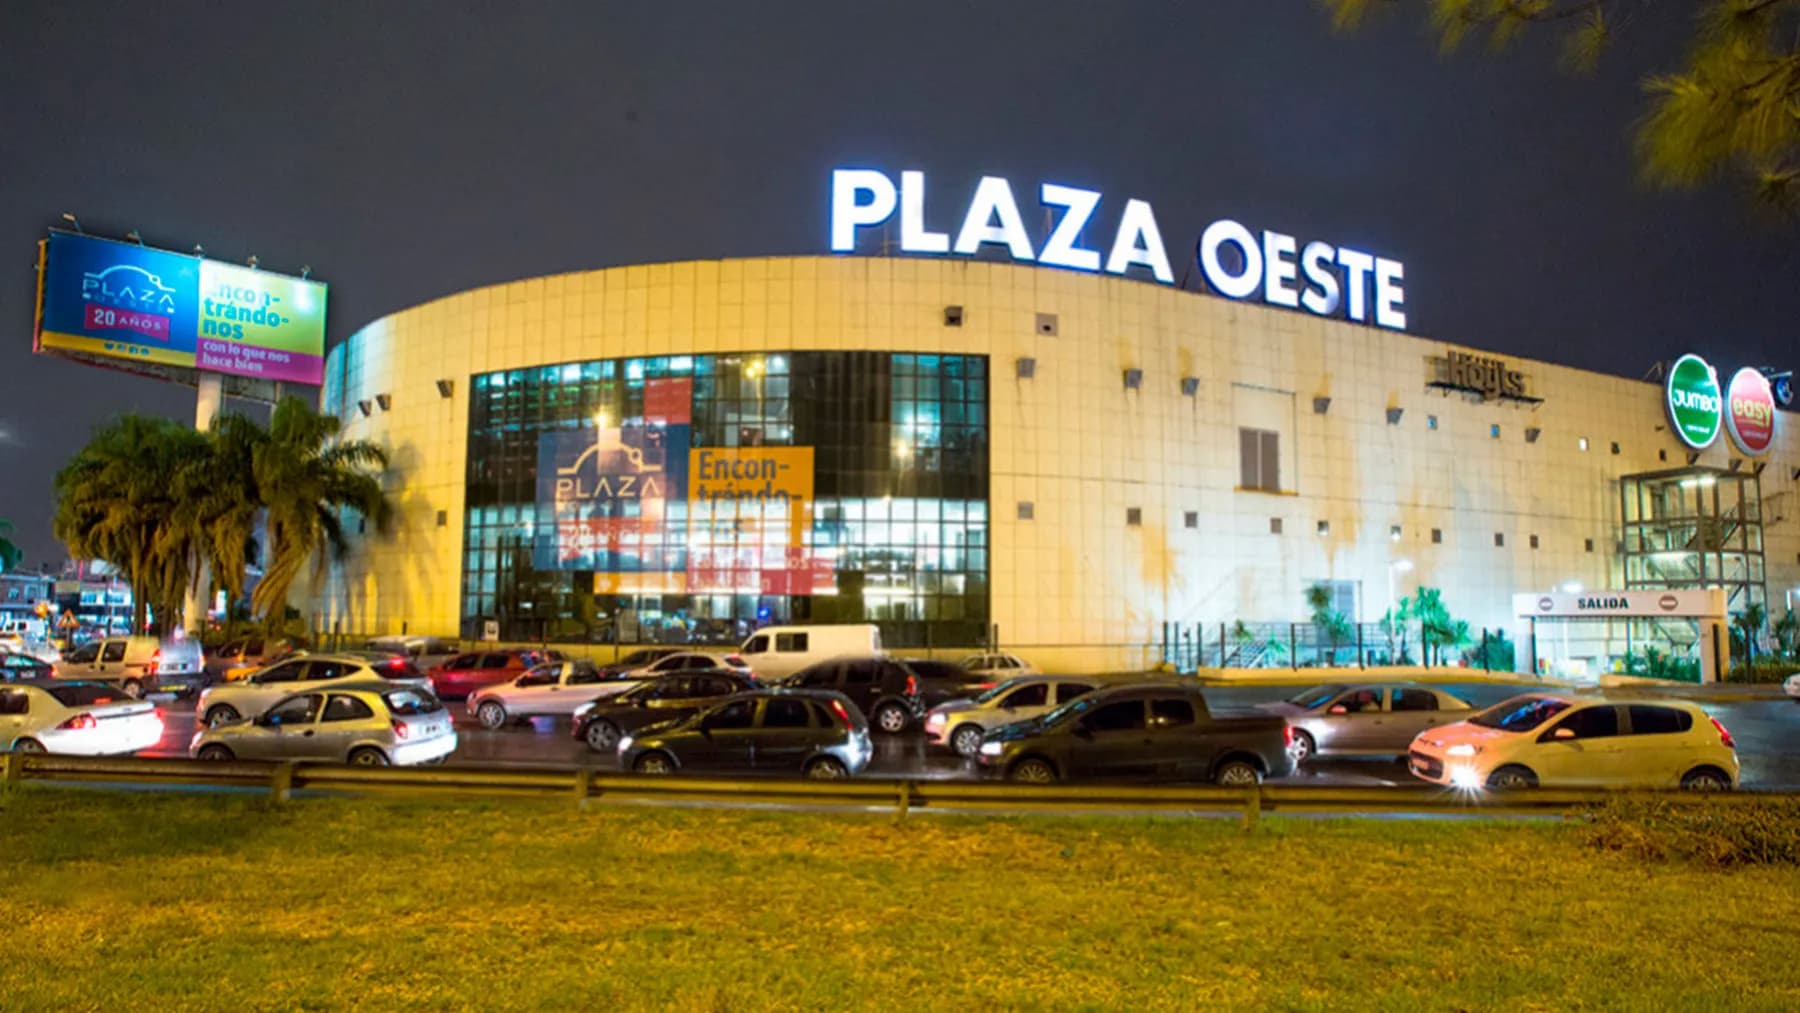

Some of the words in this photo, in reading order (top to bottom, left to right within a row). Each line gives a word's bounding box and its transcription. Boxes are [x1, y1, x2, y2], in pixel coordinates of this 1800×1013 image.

[831, 169, 1175, 284] PLAZA
[1198, 219, 1407, 330] OESTE
[82, 279, 175, 306] PLAZA
[94, 308, 116, 326] 20
[204, 297, 289, 328] trándo-
[203, 318, 244, 340] nos
[203, 341, 226, 353] con
[229, 343, 240, 355] lo
[243, 347, 266, 361] que
[268, 351, 291, 363] nos
[203, 353, 232, 369] hace
[235, 357, 263, 373] bien
[1732, 397, 1773, 428] easy
[699, 451, 791, 481] Encon-
[556, 476, 660, 498] PLAZA
[1578, 597, 1629, 610] SALIDA
